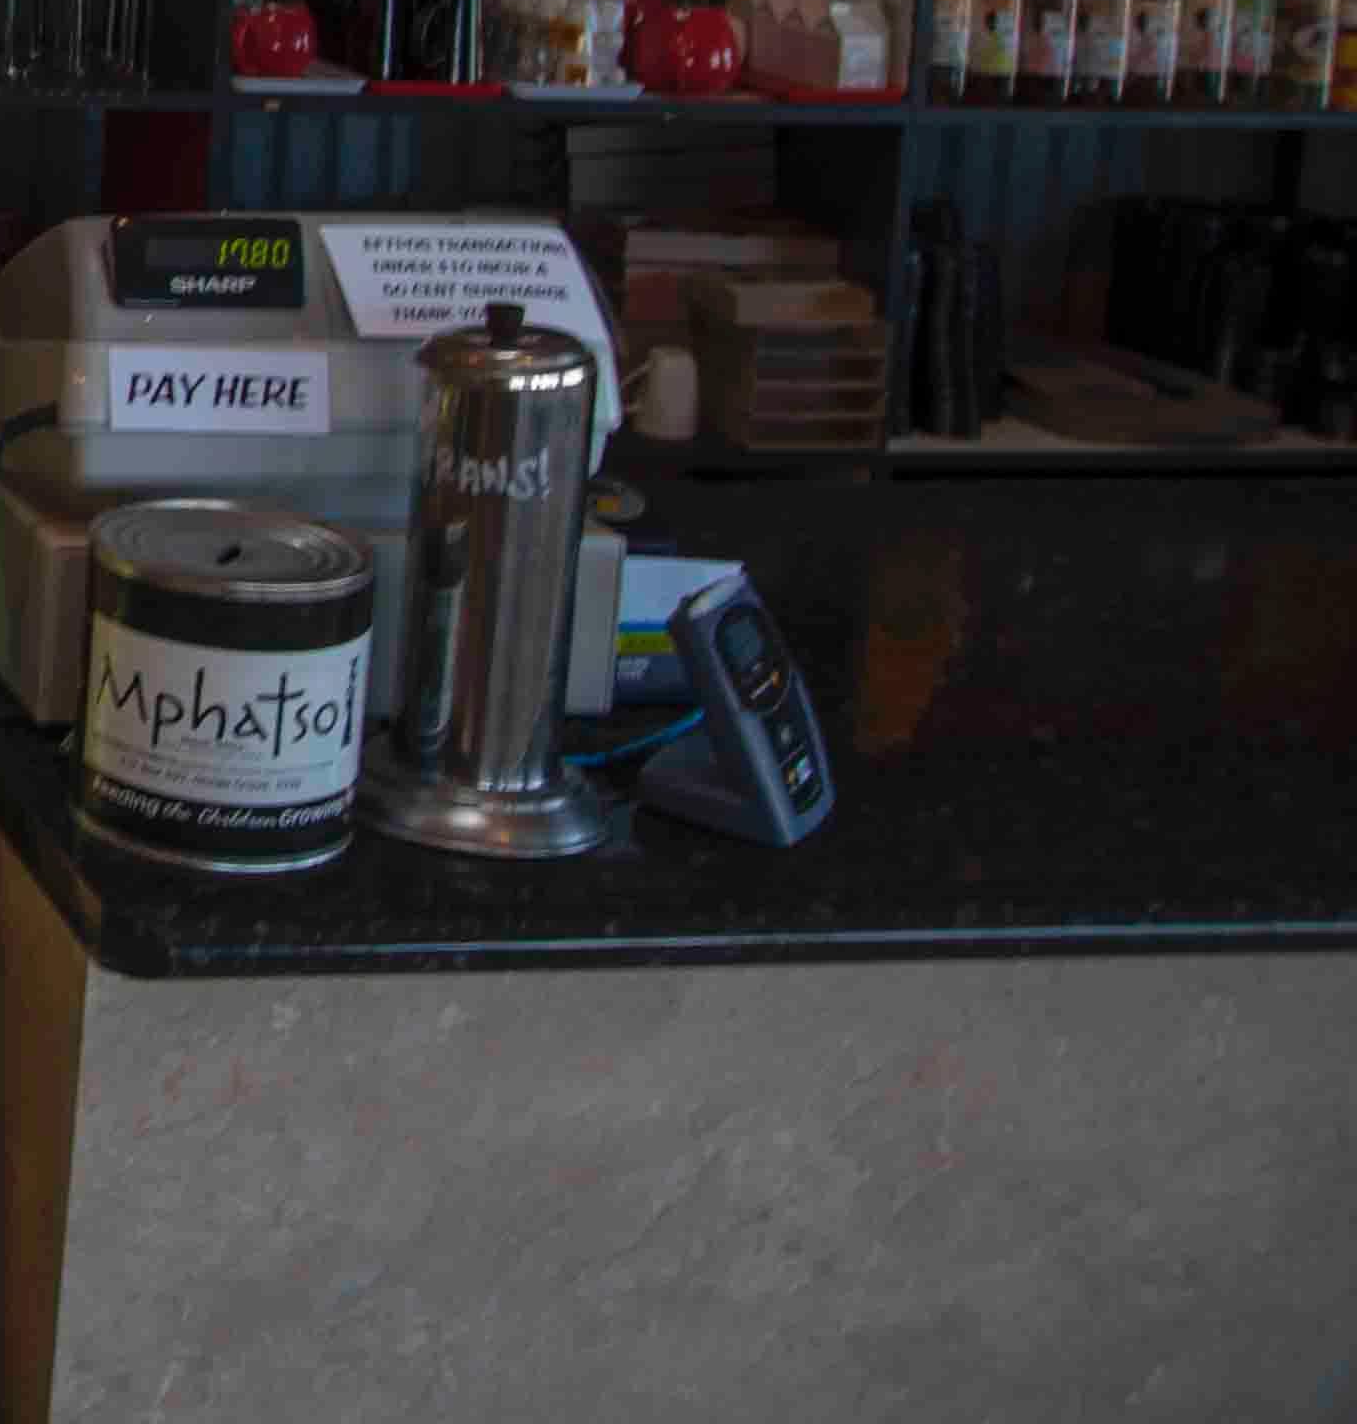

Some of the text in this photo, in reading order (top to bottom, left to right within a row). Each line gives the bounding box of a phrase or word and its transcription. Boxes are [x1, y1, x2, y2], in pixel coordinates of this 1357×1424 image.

[169, 275, 257, 297] SHARP
[127, 371, 309, 411] PAY HERE
